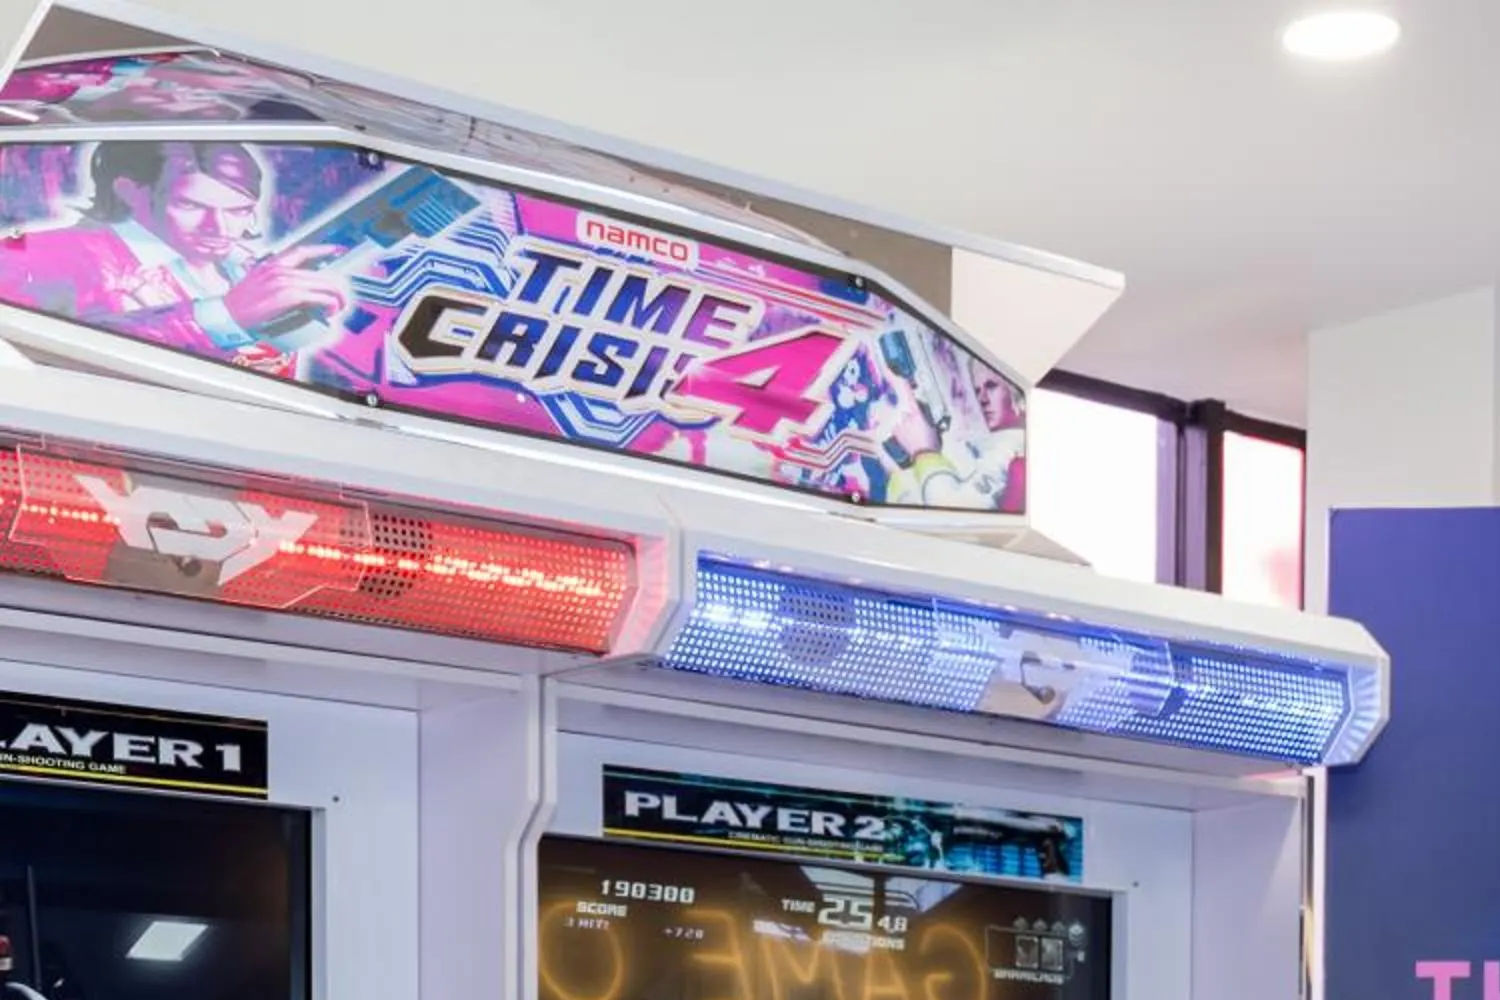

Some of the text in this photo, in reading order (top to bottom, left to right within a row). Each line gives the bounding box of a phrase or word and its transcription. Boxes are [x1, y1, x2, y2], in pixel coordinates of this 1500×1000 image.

[586, 219, 689, 263] namco
[518, 249, 752, 350] TIME
[670, 329, 849, 435] 4
[0, 722, 242, 772] AYER 1
[0, 754, 127, 775] N-SHOOTING GAME
[624, 790, 886, 841] PLAYER 2
[576, 900, 628, 917] SCORE
[601, 879, 695, 904] 190300
[781, 898, 816, 914] TIME
